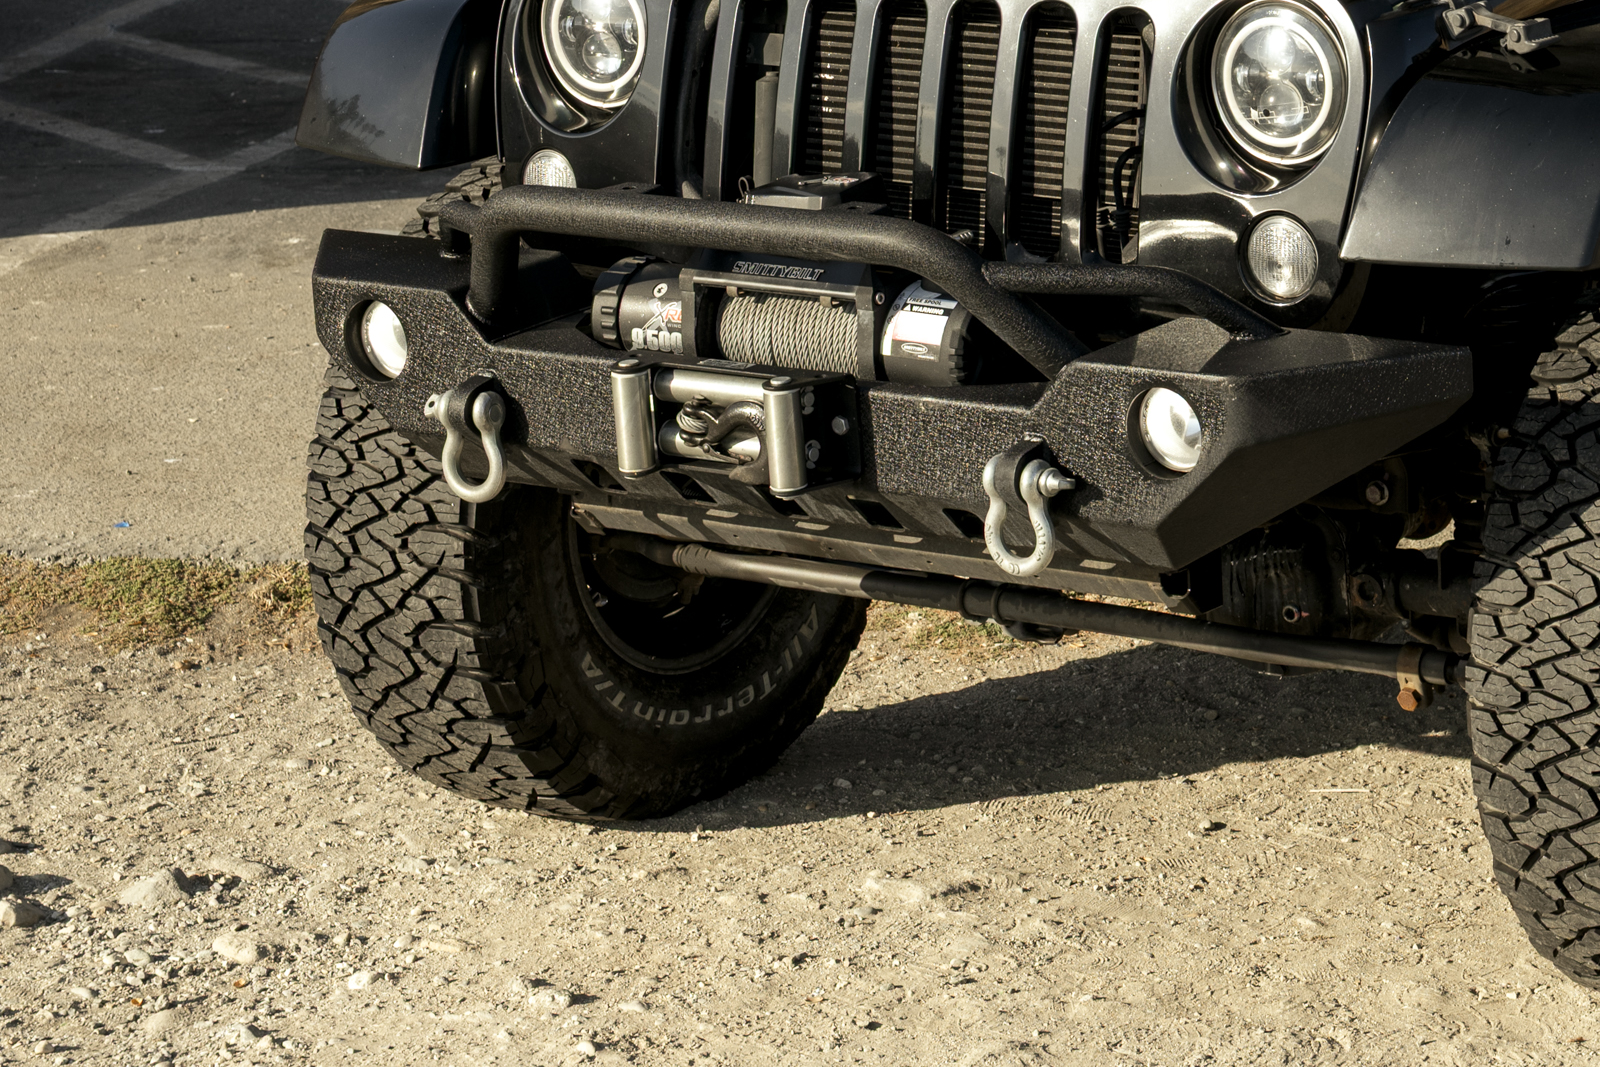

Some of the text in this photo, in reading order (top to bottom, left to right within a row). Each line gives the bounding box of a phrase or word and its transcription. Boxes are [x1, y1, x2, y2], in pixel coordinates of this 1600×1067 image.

[732, 260, 825, 281] SMITTYBILT
[911, 305, 945, 315] WARNING
[580, 603, 820, 730] All-Terrain T/A
